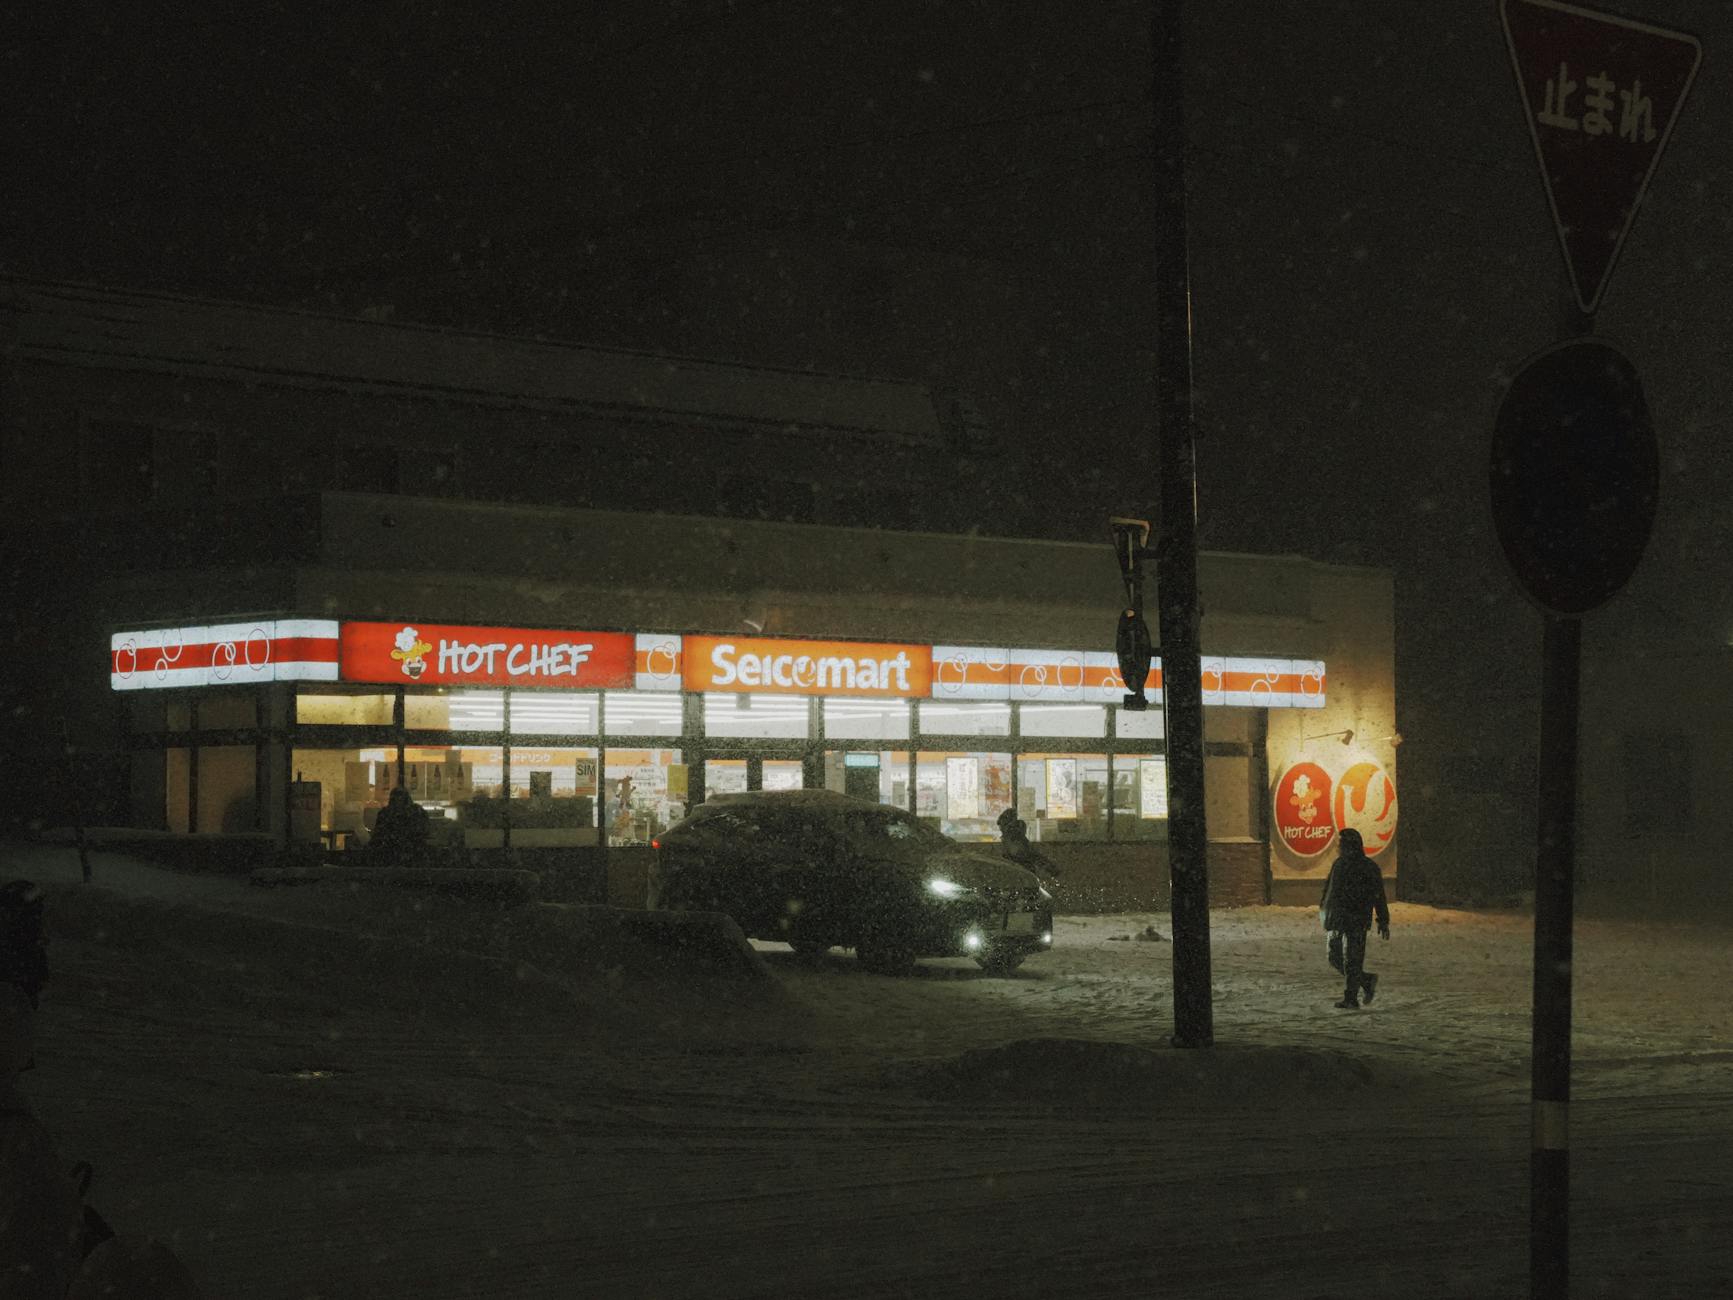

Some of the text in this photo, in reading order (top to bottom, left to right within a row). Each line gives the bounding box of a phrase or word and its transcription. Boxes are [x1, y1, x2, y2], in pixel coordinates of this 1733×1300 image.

[1537, 61, 1657, 143] 止まれ
[437, 639, 594, 677] HOT CHEF
[711, 643, 910, 690] Seicomart
[576, 764, 596, 776] SIM
[1284, 825, 1332, 839] HOT CHEF
